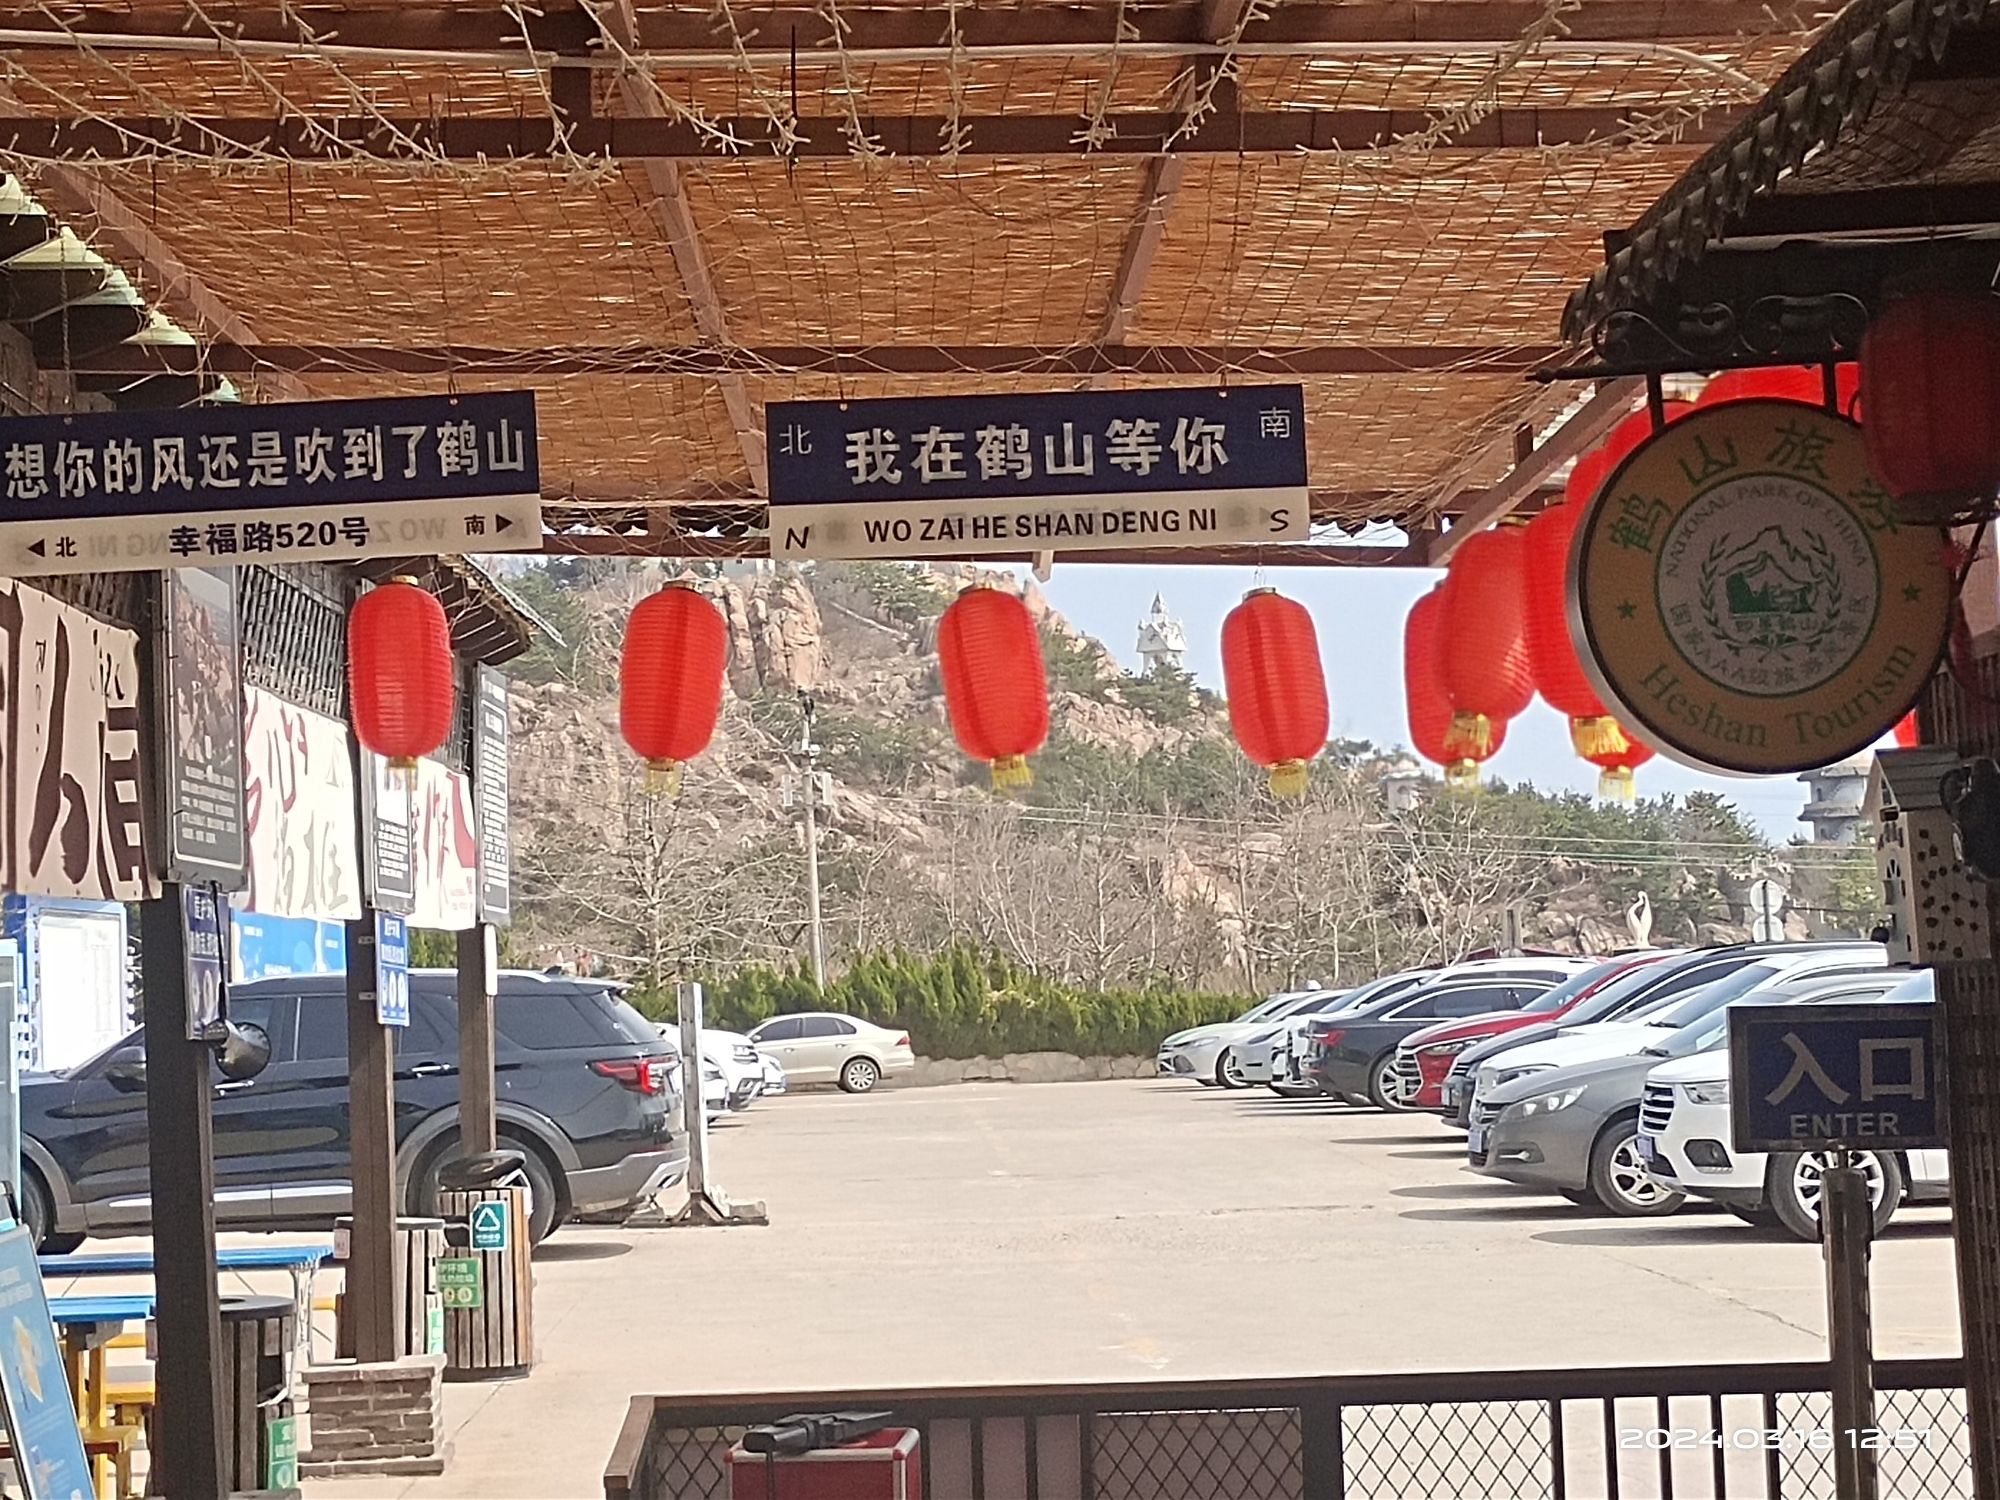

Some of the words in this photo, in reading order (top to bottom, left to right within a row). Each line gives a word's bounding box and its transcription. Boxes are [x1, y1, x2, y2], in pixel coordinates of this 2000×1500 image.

[4, 418, 525, 500] 想你的风还是吹到了鹤山
[779, 423, 813, 456] 北
[845, 415, 1230, 485] 我在鹤山等你
[1259, 406, 1291, 440] 南
[1737, 484, 1791, 501] PARK
[55, 536, 78, 559] 北
[169, 516, 371, 558] 幸福路520号
[464, 514, 486, 537] 南
[784, 525, 811, 551] N
[864, 519, 912, 545] WO
[920, 516, 963, 542] ZAI
[973, 514, 1008, 540] HE
[1015, 511, 1093, 539] SHAN
[1103, 509, 1180, 534] DENG
[1189, 508, 1218, 531] NI
[1269, 508, 1290, 532] S
[1639, 662, 1768, 748] Heshan
[1784, 644, 1917, 745] Tourism
[1764, 1031, 1925, 1105] 入口
[1790, 1112, 1900, 1138] ENTER
